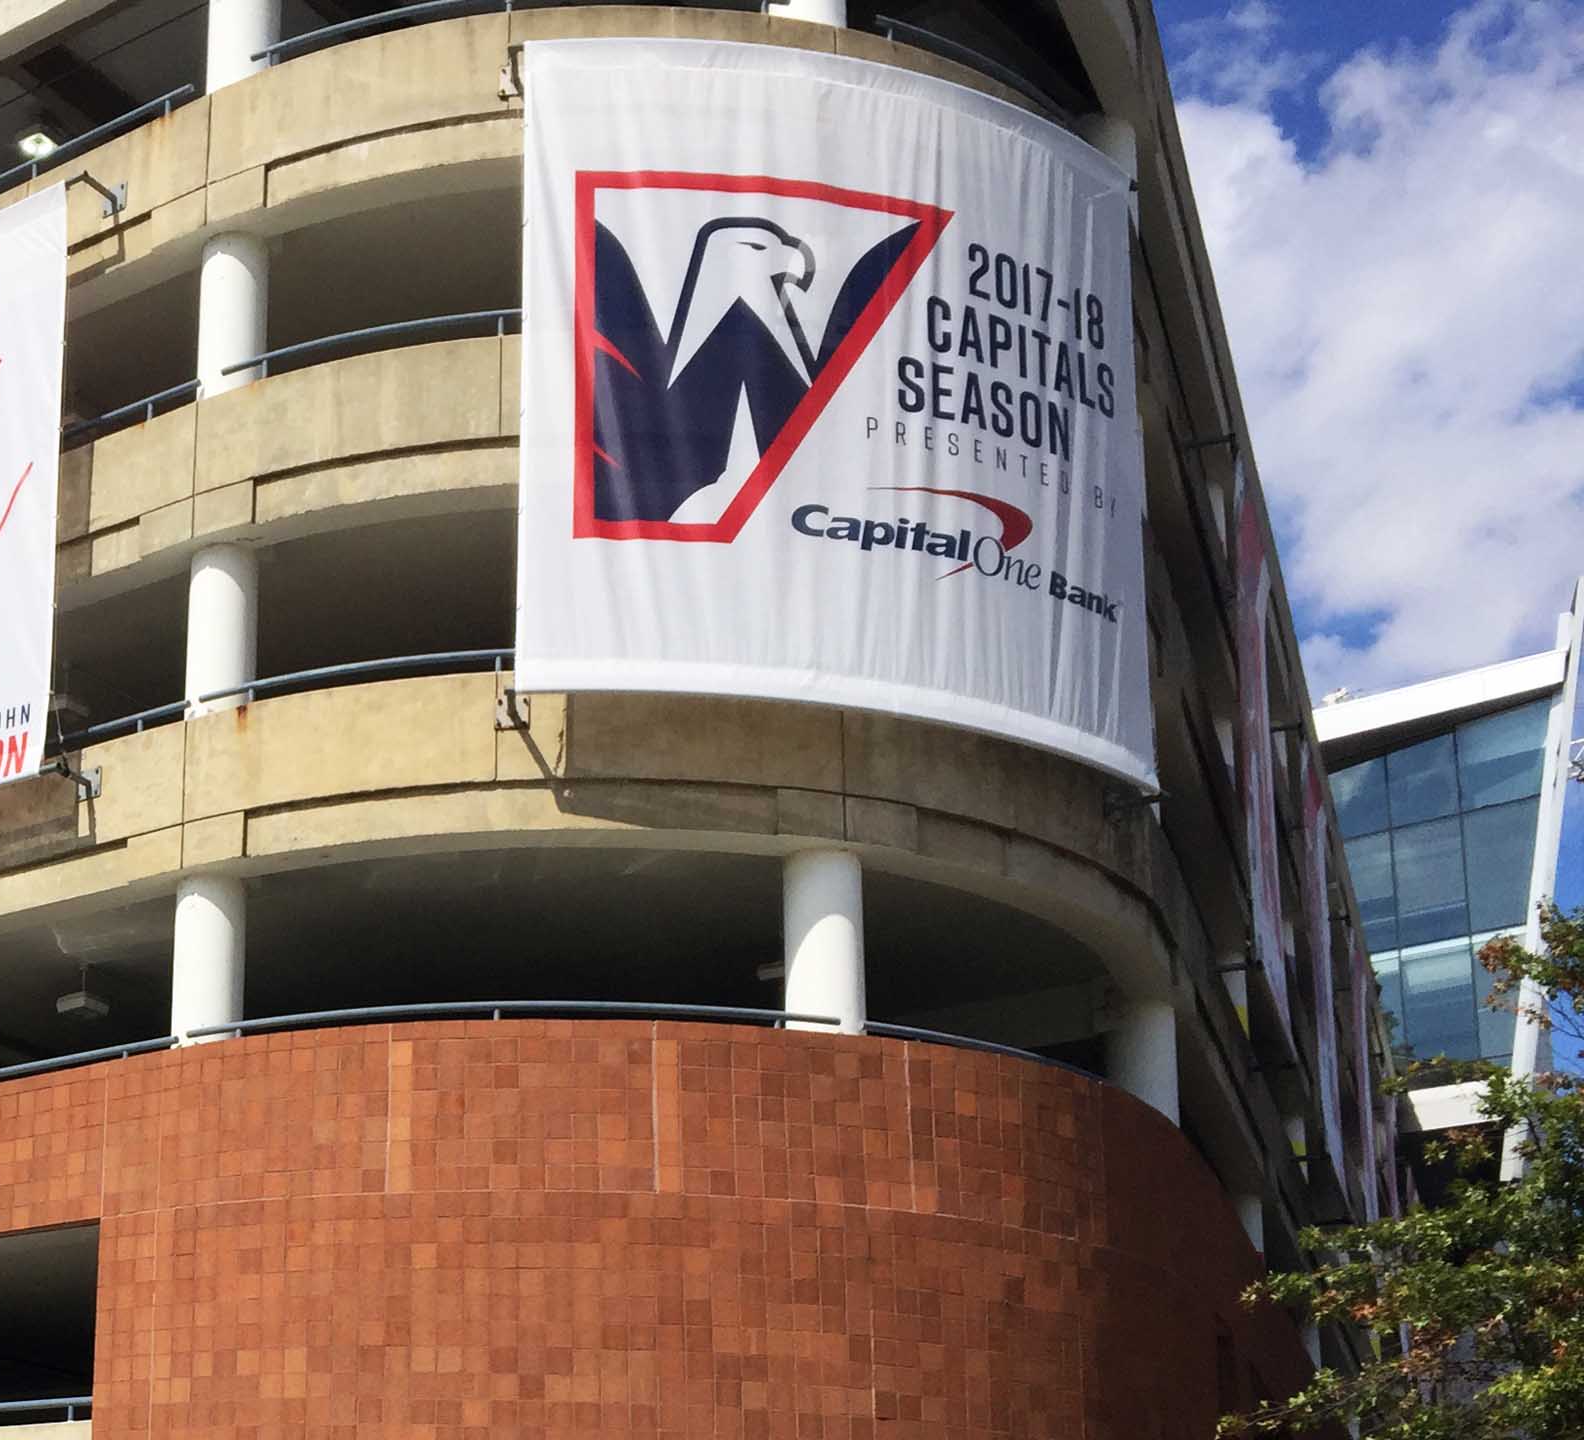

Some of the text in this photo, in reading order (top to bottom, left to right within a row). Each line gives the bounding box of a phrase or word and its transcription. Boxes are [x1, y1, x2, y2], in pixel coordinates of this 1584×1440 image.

[968, 243, 1104, 350] 2017-18
[897, 356, 1070, 462] SEASON
[926, 296, 1114, 419] CAPITALS
[791, 504, 1117, 623] Capital One Bank
